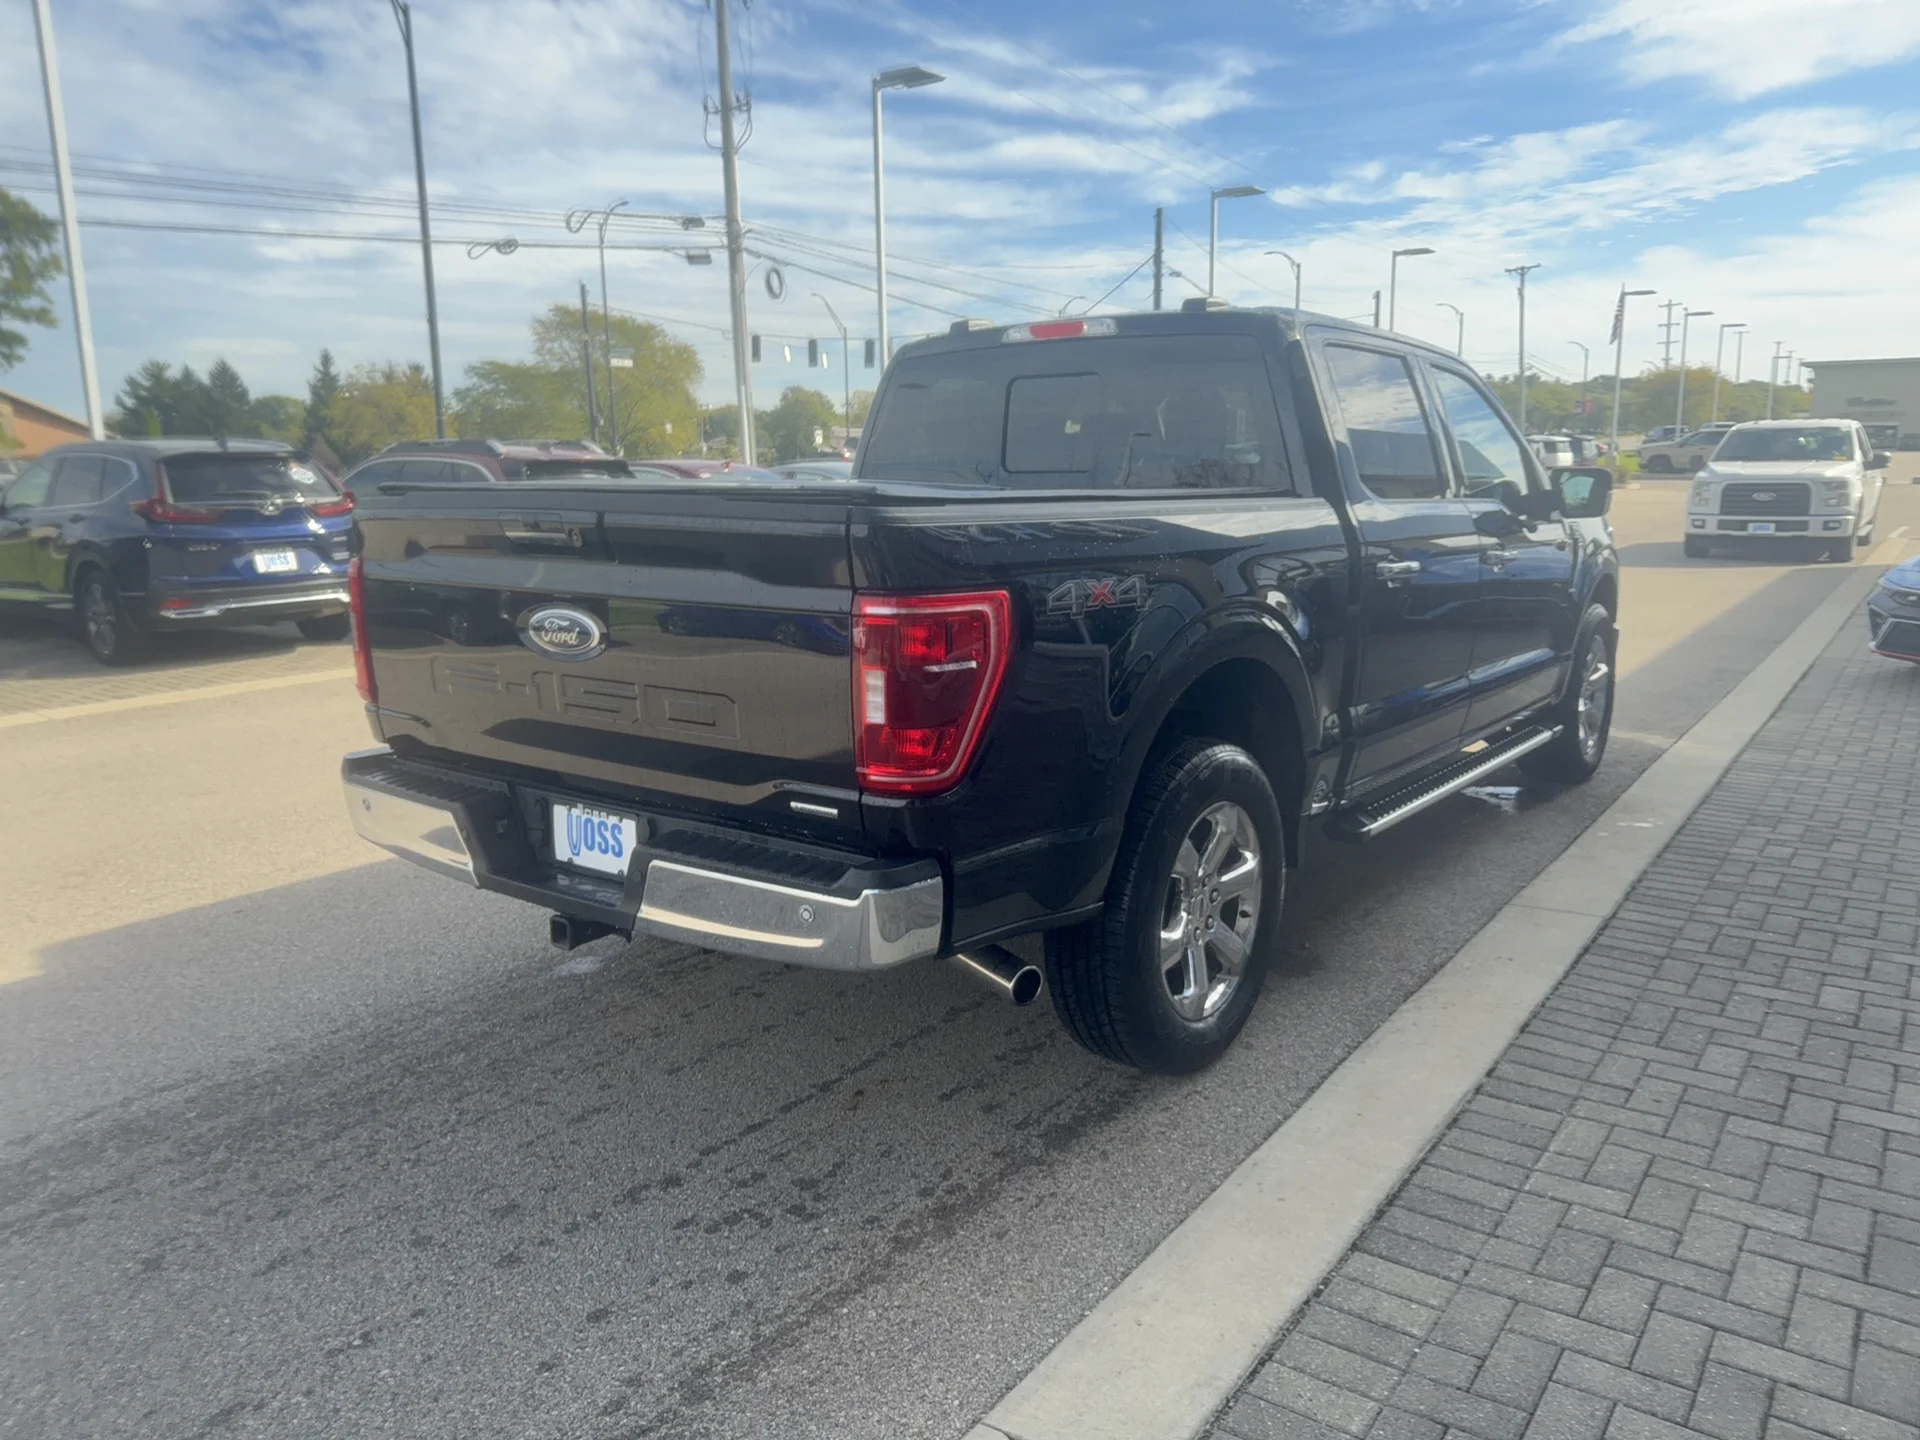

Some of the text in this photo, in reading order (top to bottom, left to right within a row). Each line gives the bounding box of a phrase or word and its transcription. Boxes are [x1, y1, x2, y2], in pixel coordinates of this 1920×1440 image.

[541, 618, 580, 645] Ford
[430, 655, 740, 740] F-150
[566, 811, 624, 858] VOSS
